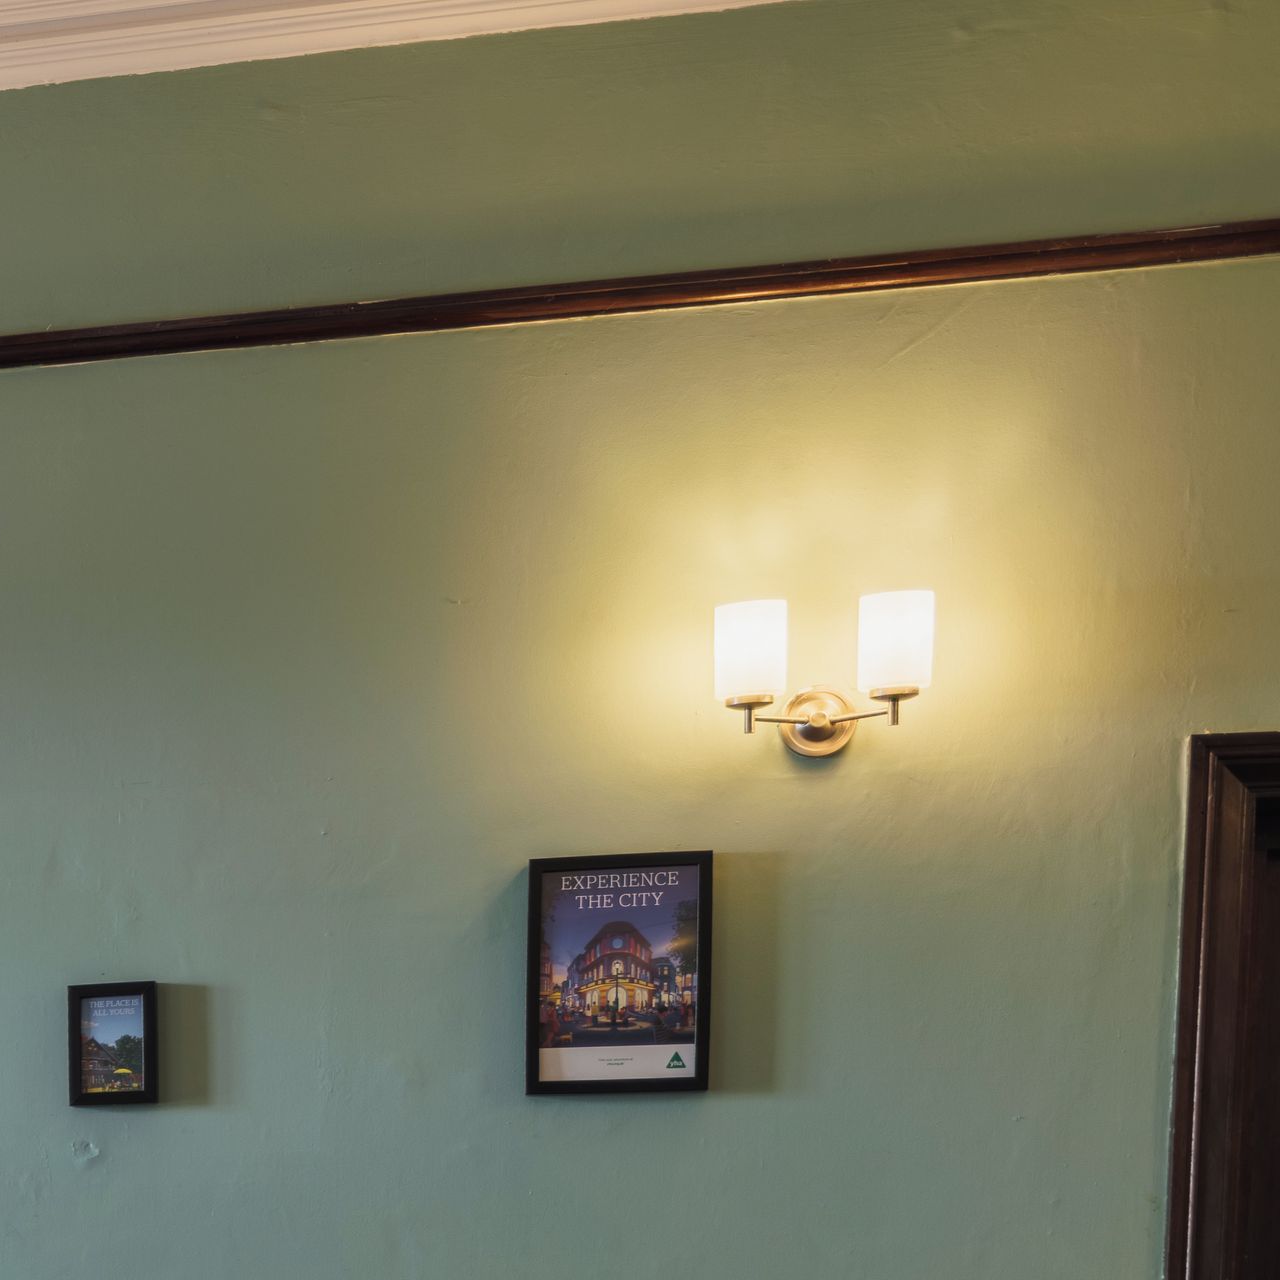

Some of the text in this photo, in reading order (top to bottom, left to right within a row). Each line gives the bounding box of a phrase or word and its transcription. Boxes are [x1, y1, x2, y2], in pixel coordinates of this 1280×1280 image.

[561, 871, 679, 891] EXPERIENCE
[575, 891, 664, 910] THE CITY
[89, 1000, 105, 1008] THE
[106, 999, 130, 1008] PLACE
[92, 1007, 135, 1017] ALL YOURS
